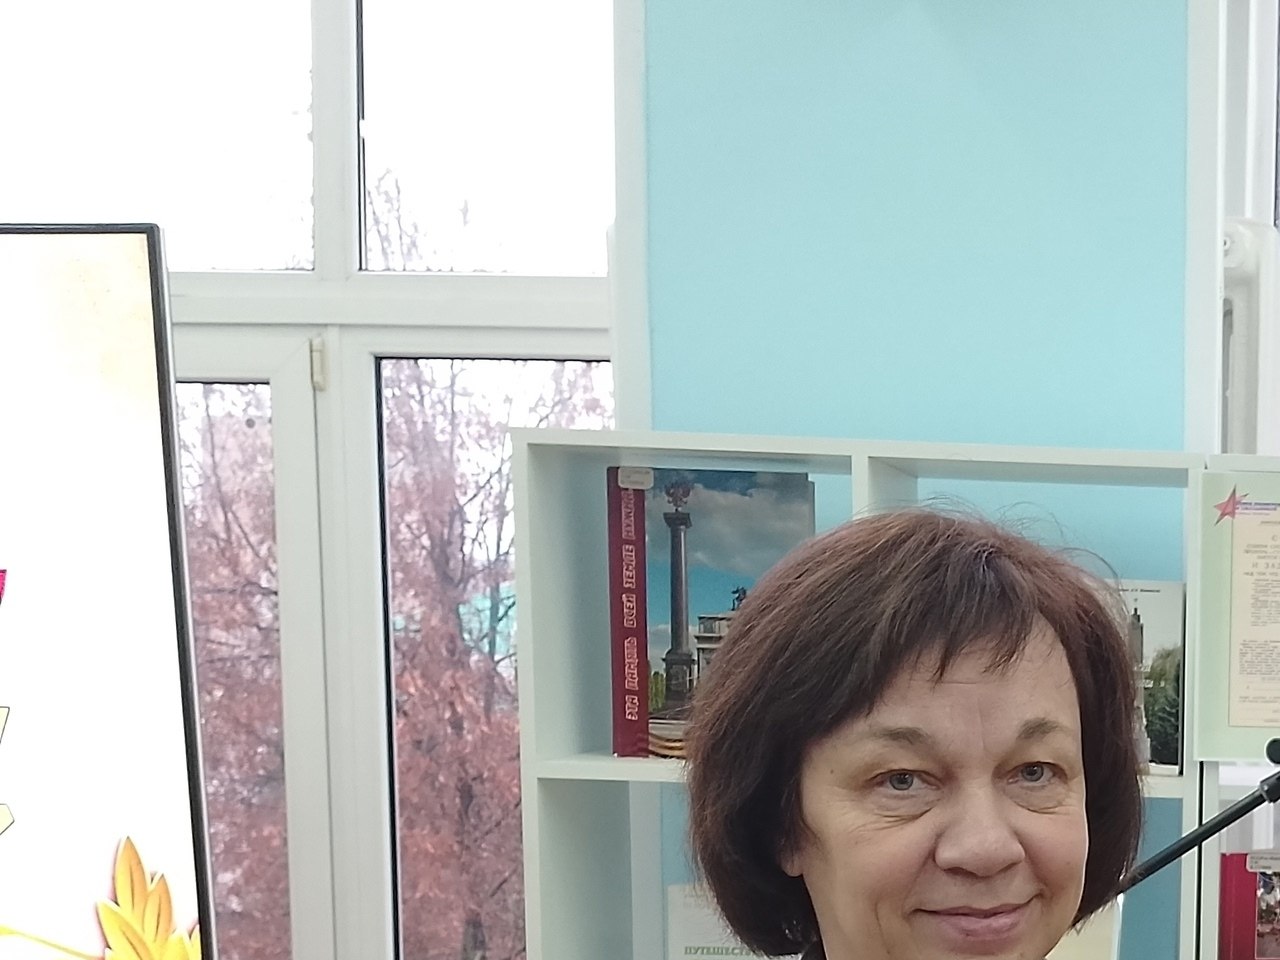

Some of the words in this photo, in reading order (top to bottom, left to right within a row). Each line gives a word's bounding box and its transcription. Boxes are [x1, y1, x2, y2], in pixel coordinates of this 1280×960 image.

[622, 544, 636, 589] ЗЕМЛЕ
[622, 593, 637, 628] ВСЕЙ
[625, 637, 639, 690] ПАМЯТЬ
[626, 695, 639, 721] ЭТА
